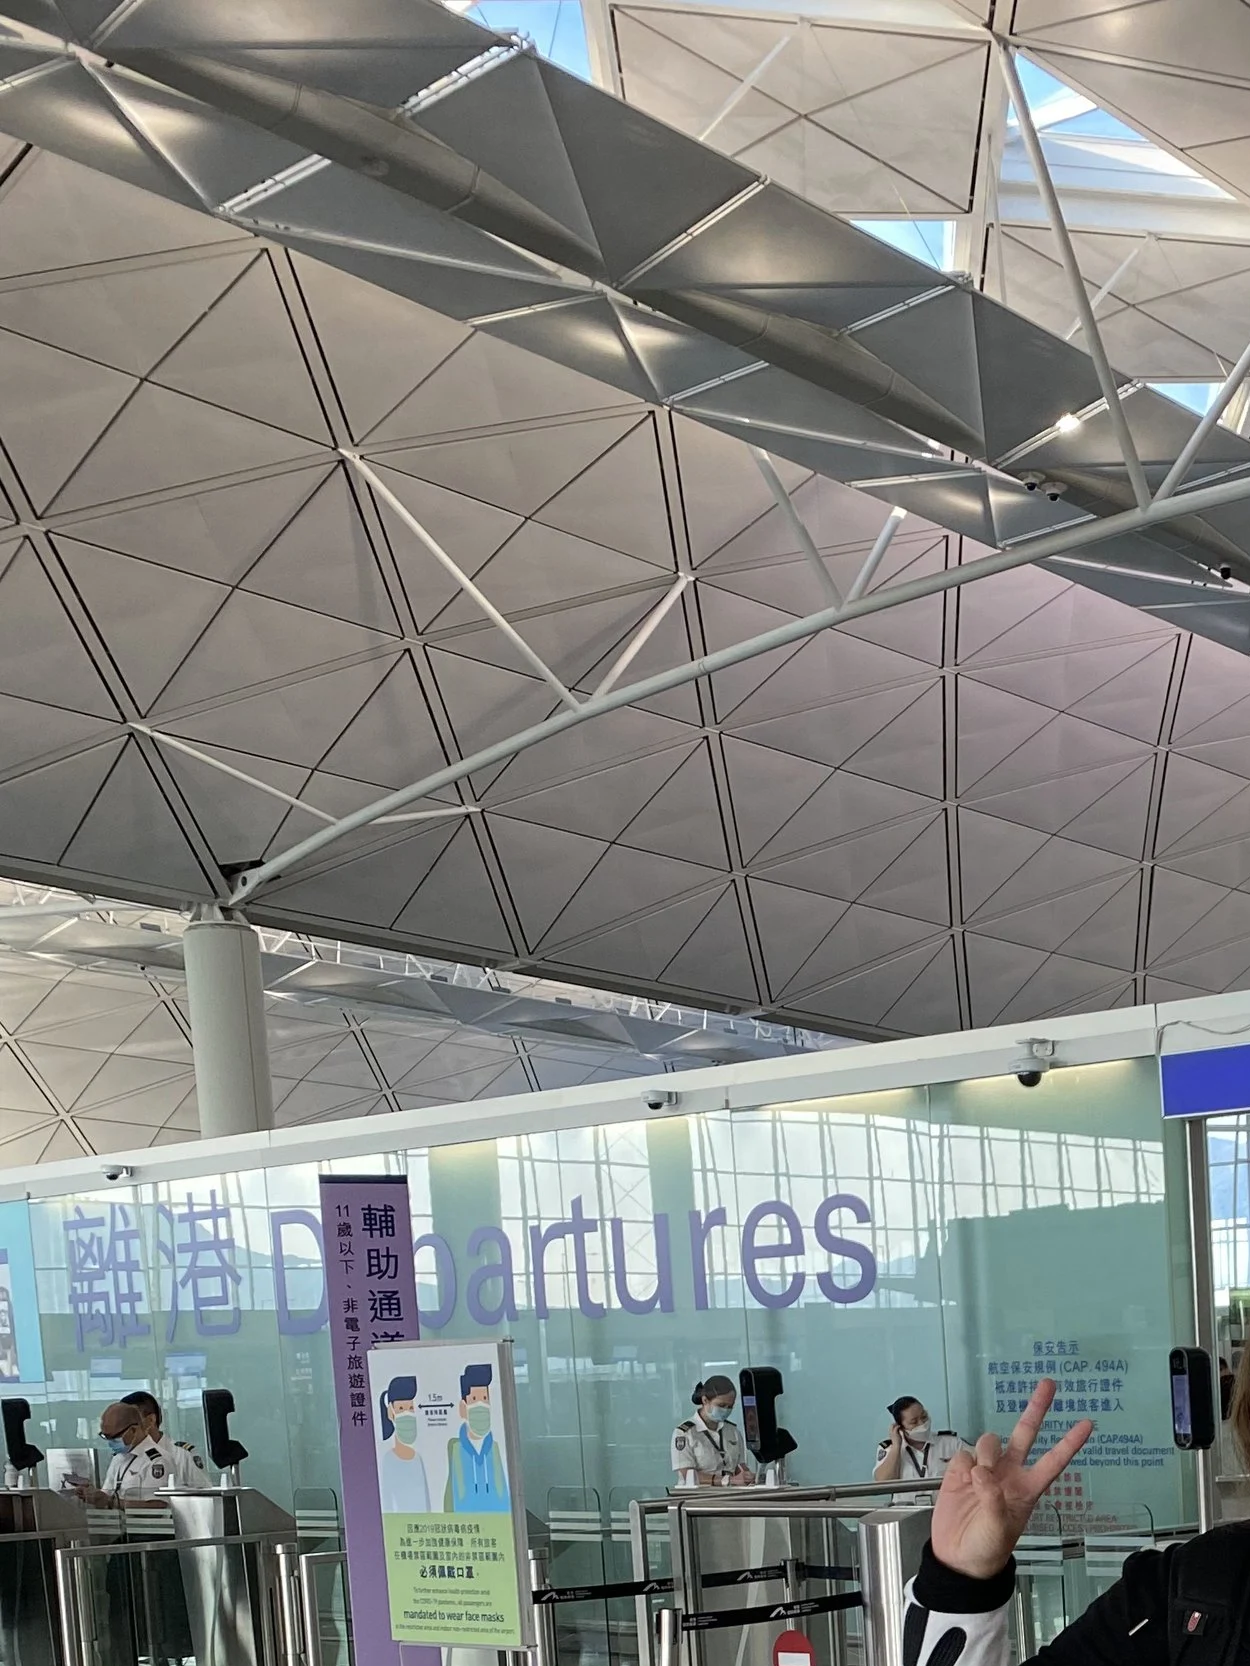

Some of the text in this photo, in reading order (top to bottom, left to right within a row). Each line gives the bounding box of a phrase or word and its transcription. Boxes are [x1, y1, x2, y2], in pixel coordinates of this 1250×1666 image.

[62, 1188, 242, 1353] 離港
[1033, 1340, 1080, 1355] 保安告示
[1082, 1445, 1175, 1455] valid travel document
[1089, 1457, 1121, 1467] beyond
[1123, 1457, 1139, 1466] this
[1141, 1457, 1164, 1467] point
[403, 1610, 505, 1623] mandated to wear face masks
